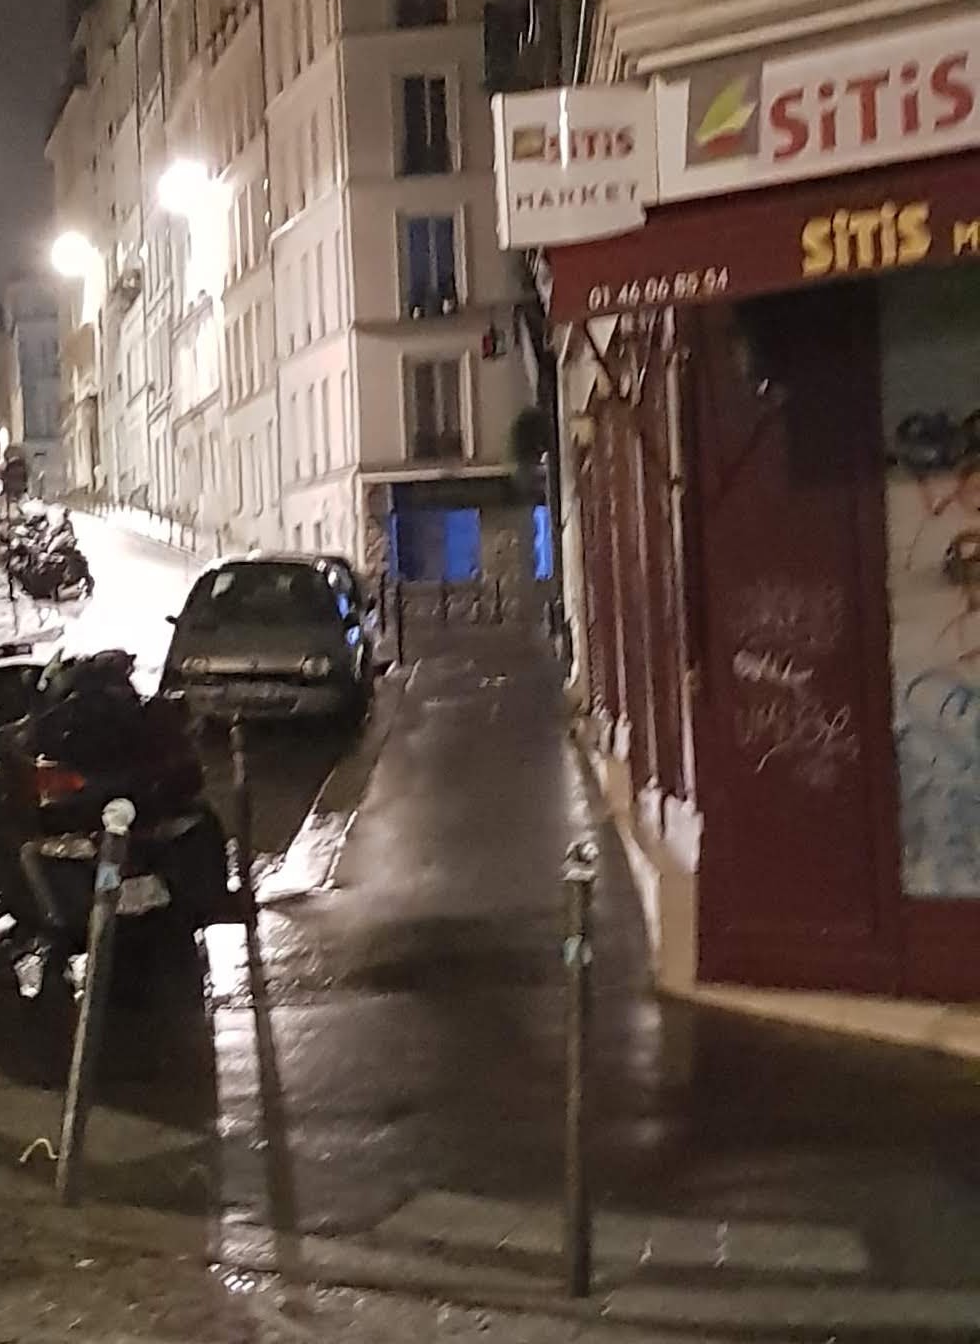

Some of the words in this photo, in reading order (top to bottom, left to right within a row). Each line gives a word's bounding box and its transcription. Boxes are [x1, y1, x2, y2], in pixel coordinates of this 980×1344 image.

[770, 51, 975, 162] SiTiS
[516, 181, 638, 210] MARKET
[588, 284, 611, 311] 01
[644, 275, 669, 303] 06
